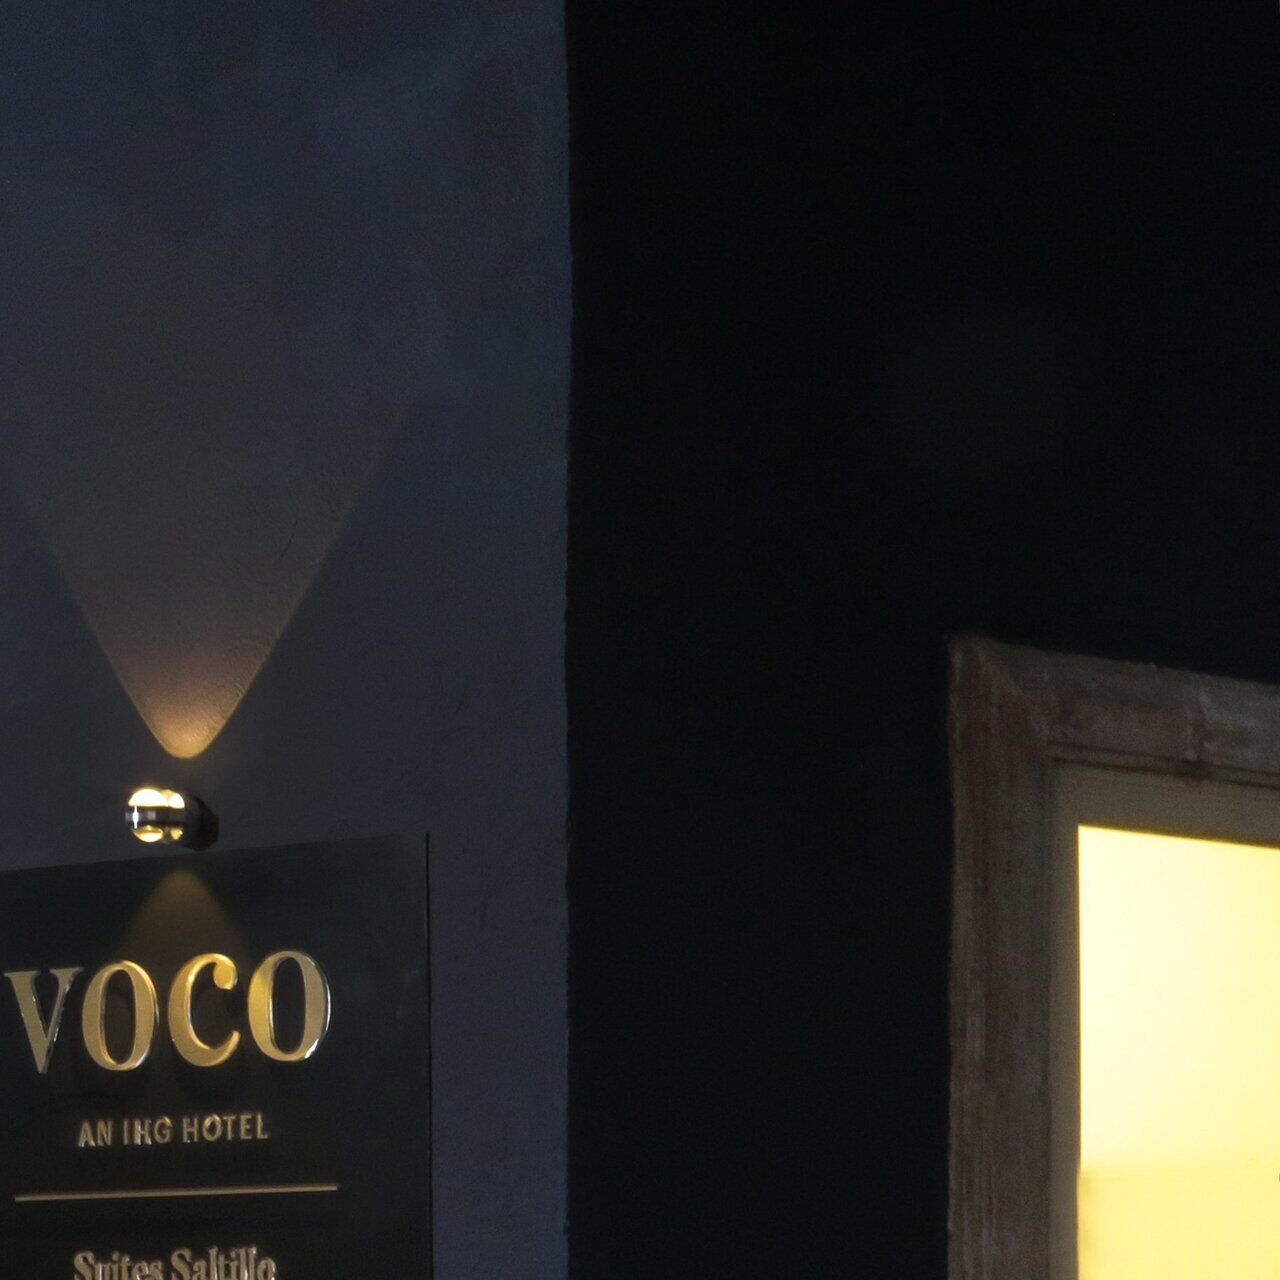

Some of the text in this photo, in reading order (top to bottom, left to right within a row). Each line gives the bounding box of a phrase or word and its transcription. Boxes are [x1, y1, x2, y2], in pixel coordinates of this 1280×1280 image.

[77, 1113, 270, 1148] AN IHG HOTEL
